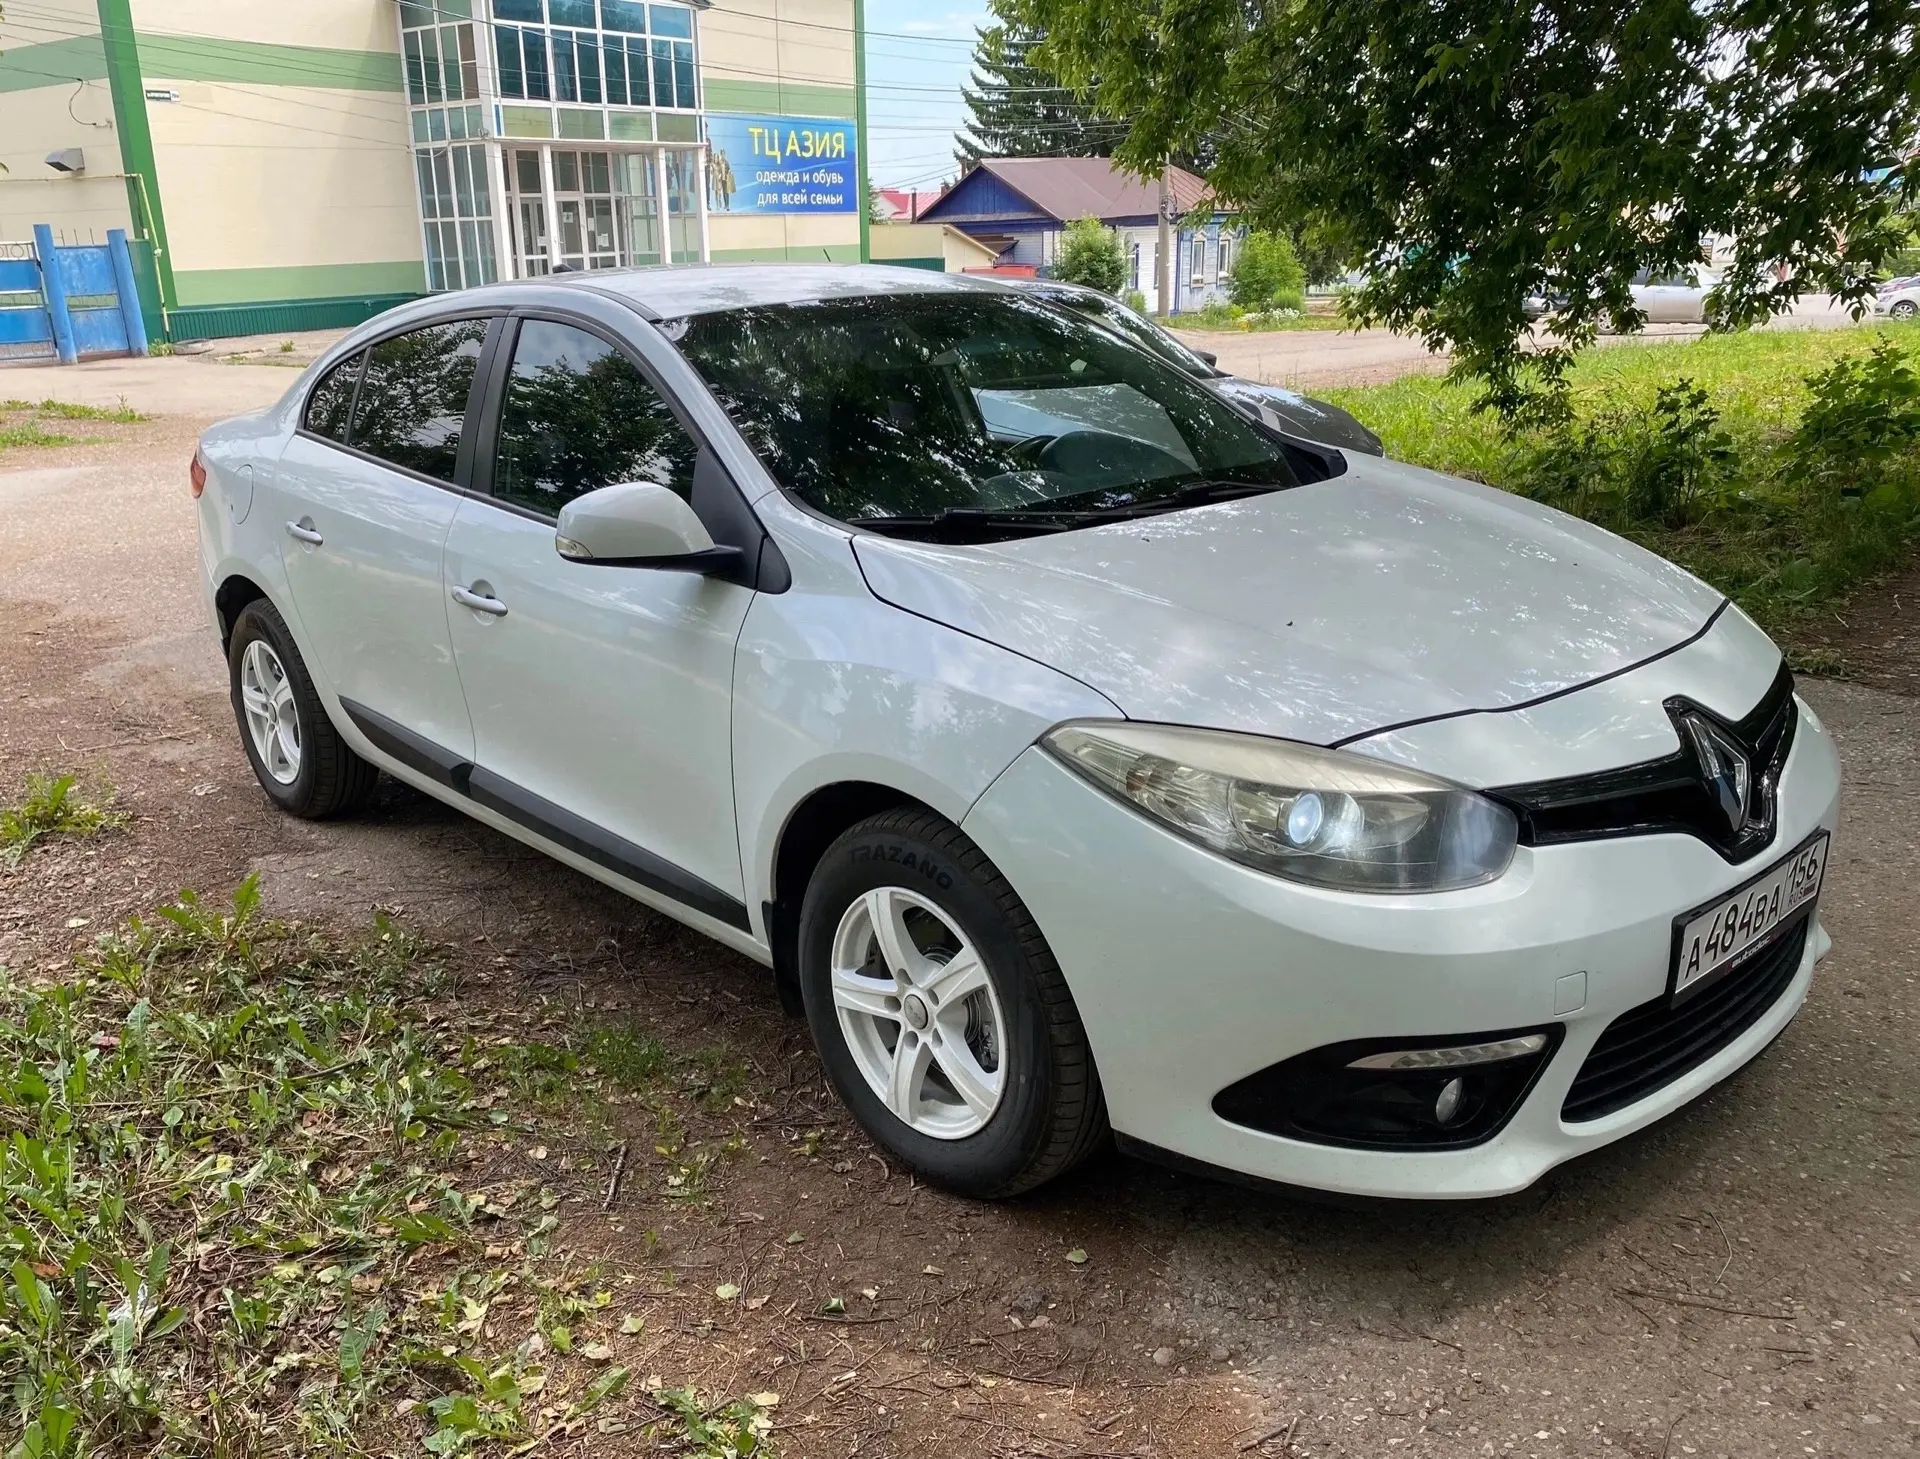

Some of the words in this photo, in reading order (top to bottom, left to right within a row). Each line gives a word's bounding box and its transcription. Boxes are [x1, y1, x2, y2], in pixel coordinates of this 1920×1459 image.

[748, 127, 781, 165] ТЦ
[785, 130, 846, 159] АЗИЯ
[756, 170, 800, 186] одежда
[803, 172, 810, 184] и
[813, 169, 844, 187] обувь
[757, 192, 779, 207] для
[782, 189, 808, 205] всей
[810, 193, 843, 205] семьи
[848, 844, 954, 891] TRAZANO
[1788, 844, 1819, 894] 156
[1787, 886, 1804, 907] RUS
